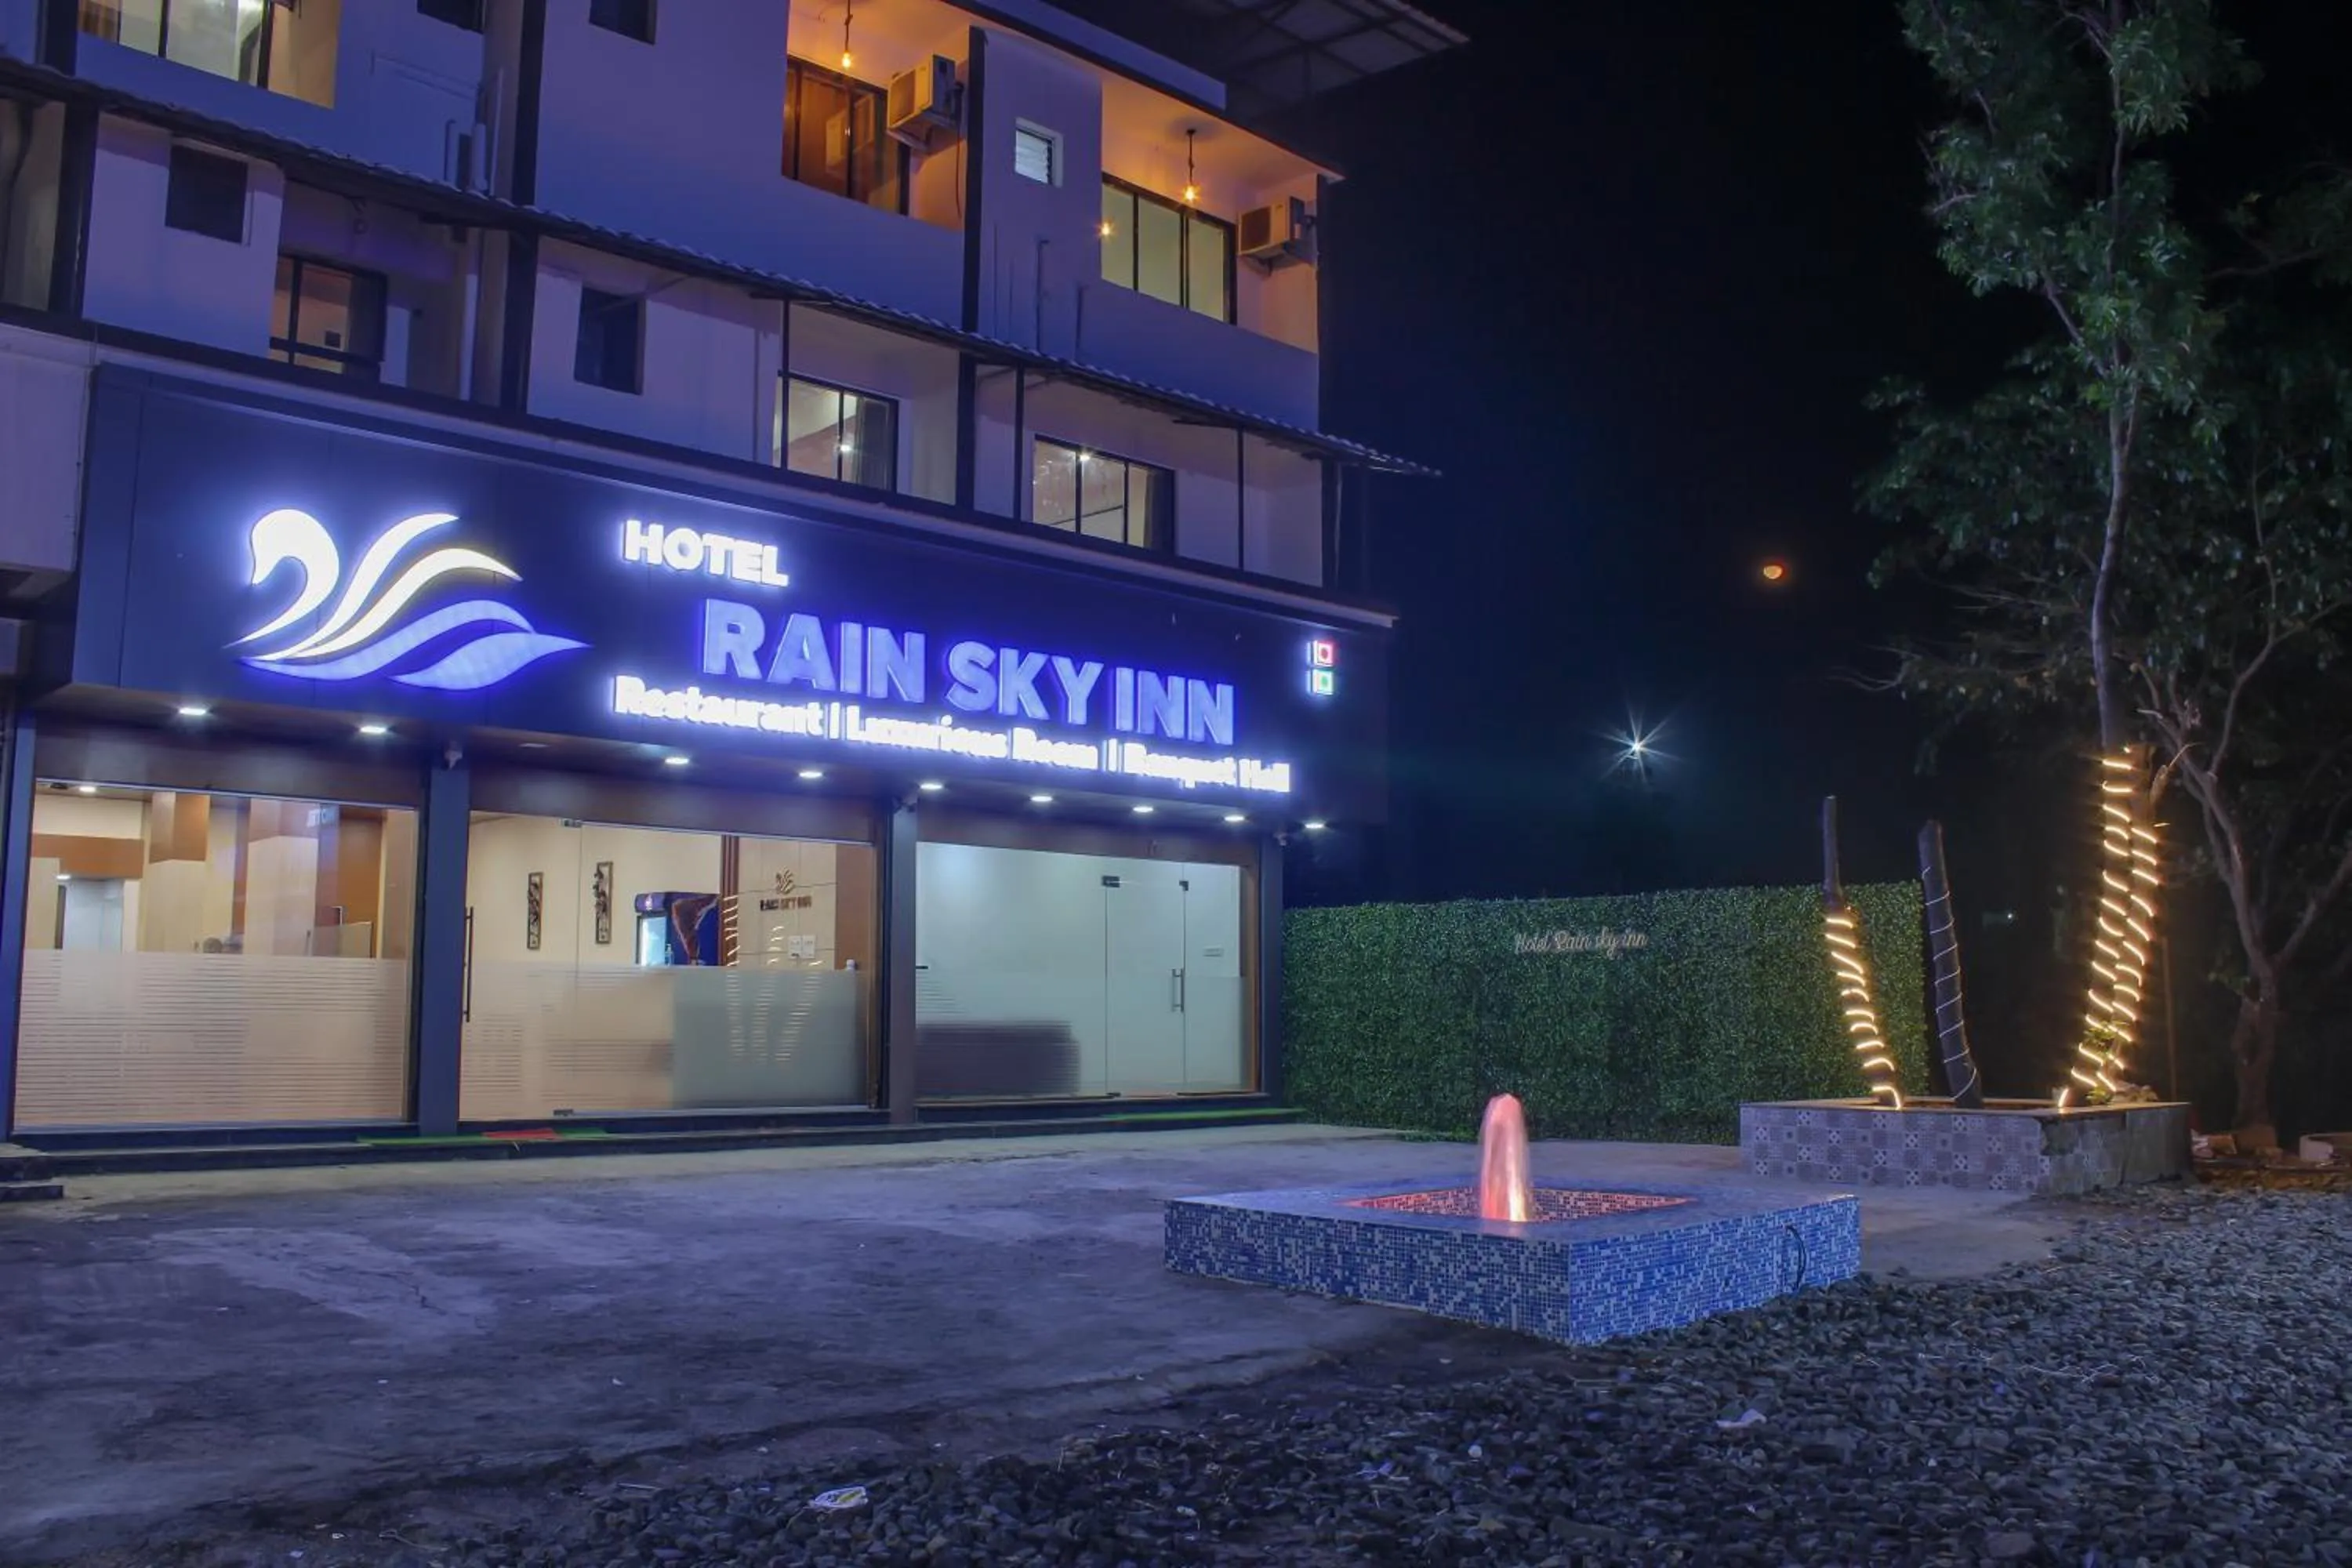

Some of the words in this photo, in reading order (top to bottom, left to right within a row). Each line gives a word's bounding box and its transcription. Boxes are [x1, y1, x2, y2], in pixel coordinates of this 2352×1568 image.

[624, 520, 789, 586] HOTEL
[703, 598, 926, 703] RAIN
[946, 641, 1104, 725] SKY
[1114, 666, 1234, 745] INN
[615, 675, 824, 735] Restaurant
